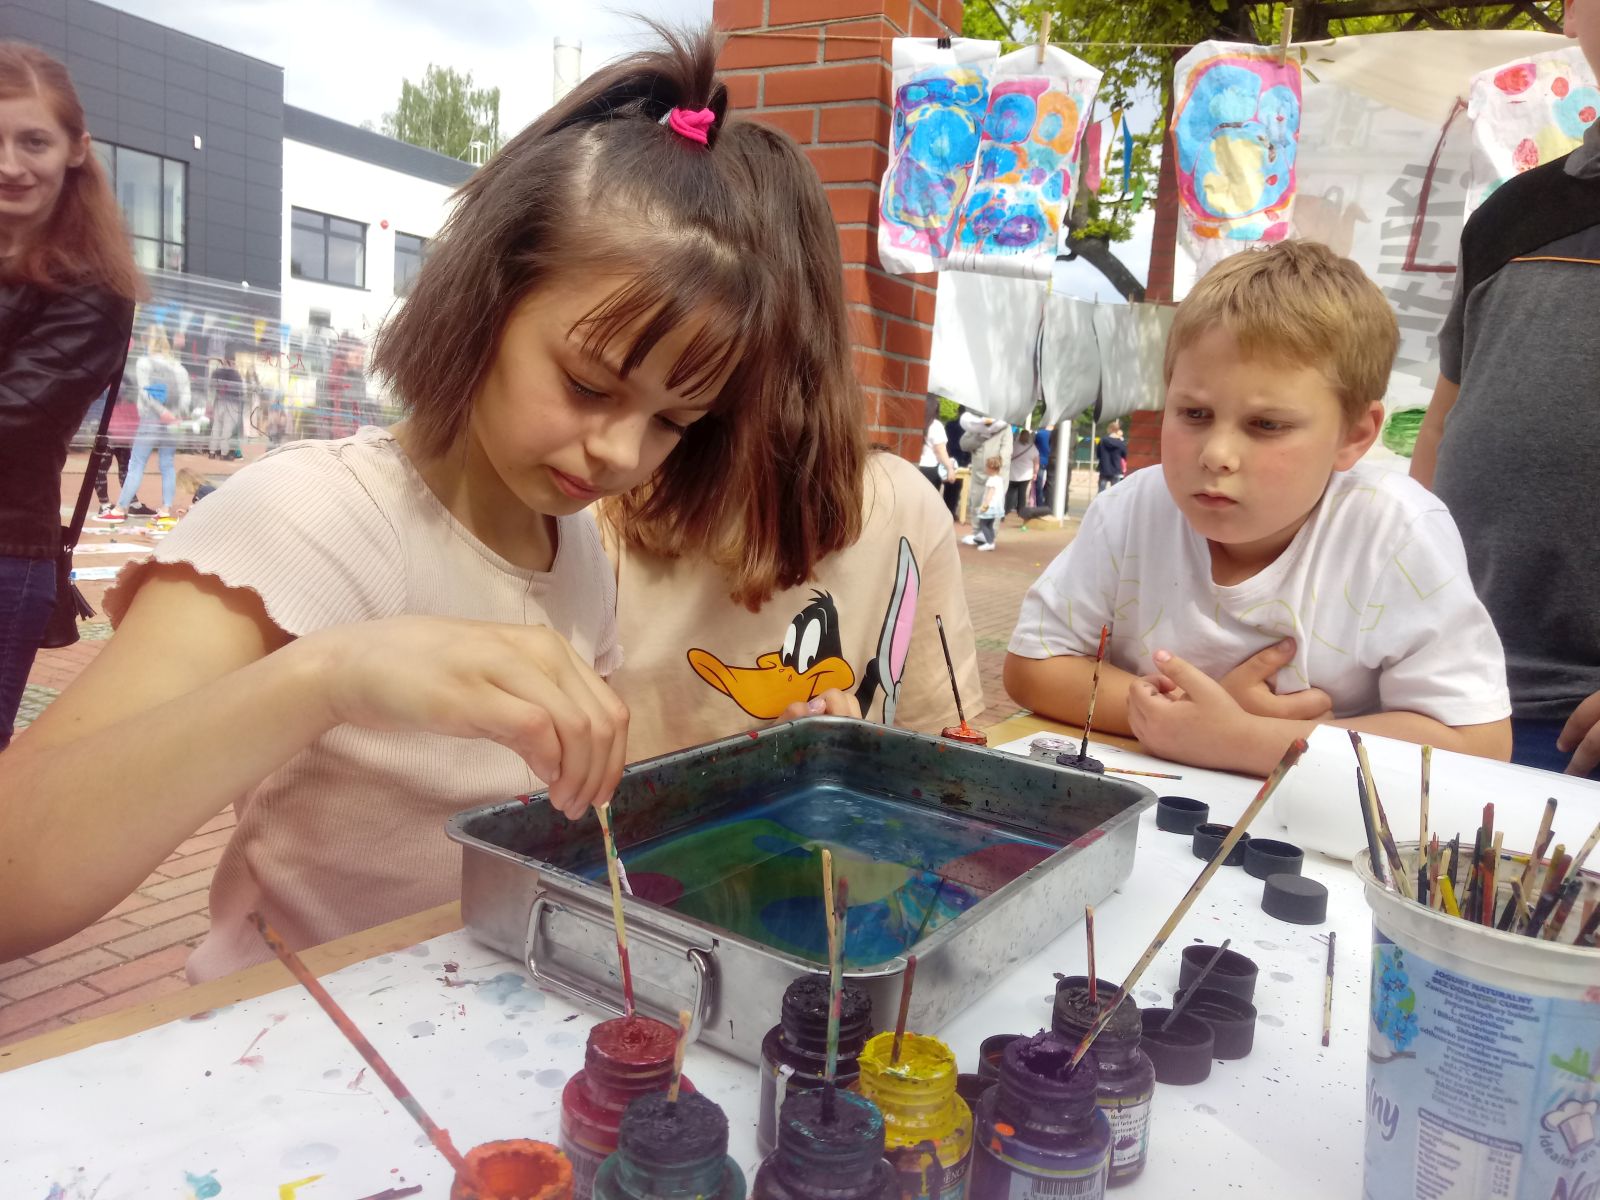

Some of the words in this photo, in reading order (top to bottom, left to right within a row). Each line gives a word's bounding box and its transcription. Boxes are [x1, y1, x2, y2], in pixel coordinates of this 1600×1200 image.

[1434, 970, 1470, 988] JOGURT
[1472, 983, 1533, 1004] NATURALNY
[1539, 1135, 1579, 1169] Idealny
